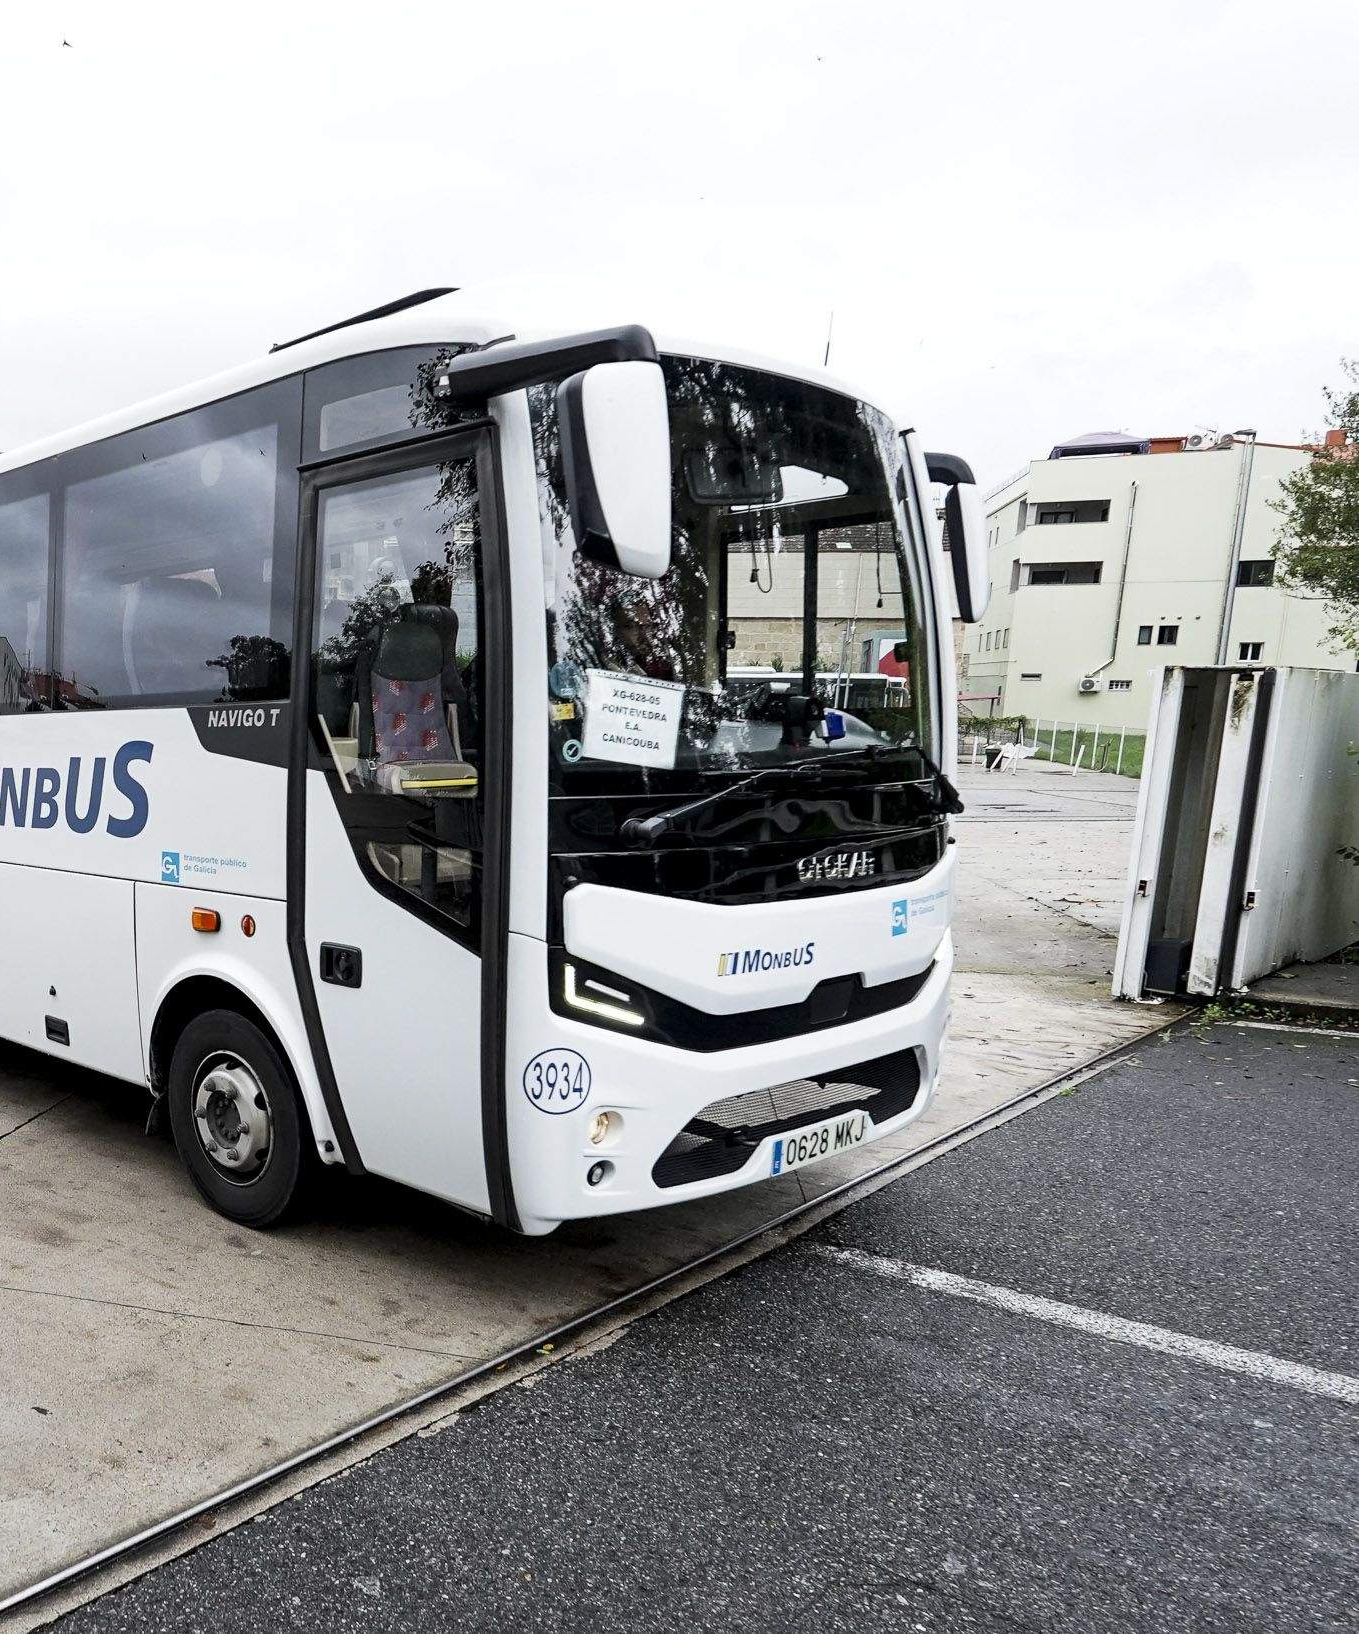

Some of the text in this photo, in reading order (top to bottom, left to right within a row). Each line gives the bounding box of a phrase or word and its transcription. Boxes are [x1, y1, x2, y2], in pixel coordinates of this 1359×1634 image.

[208, 708, 281, 728] NAVIGO T
[602, 703, 667, 722] PONTEVEDRA
[602, 733, 660, 750] CANICOUBA
[183, 854, 219, 865] transporte
[193, 864, 217, 875] Galicia
[531, 1062, 583, 1100] 3934
[786, 1115, 865, 1165] 0628 MKJ
